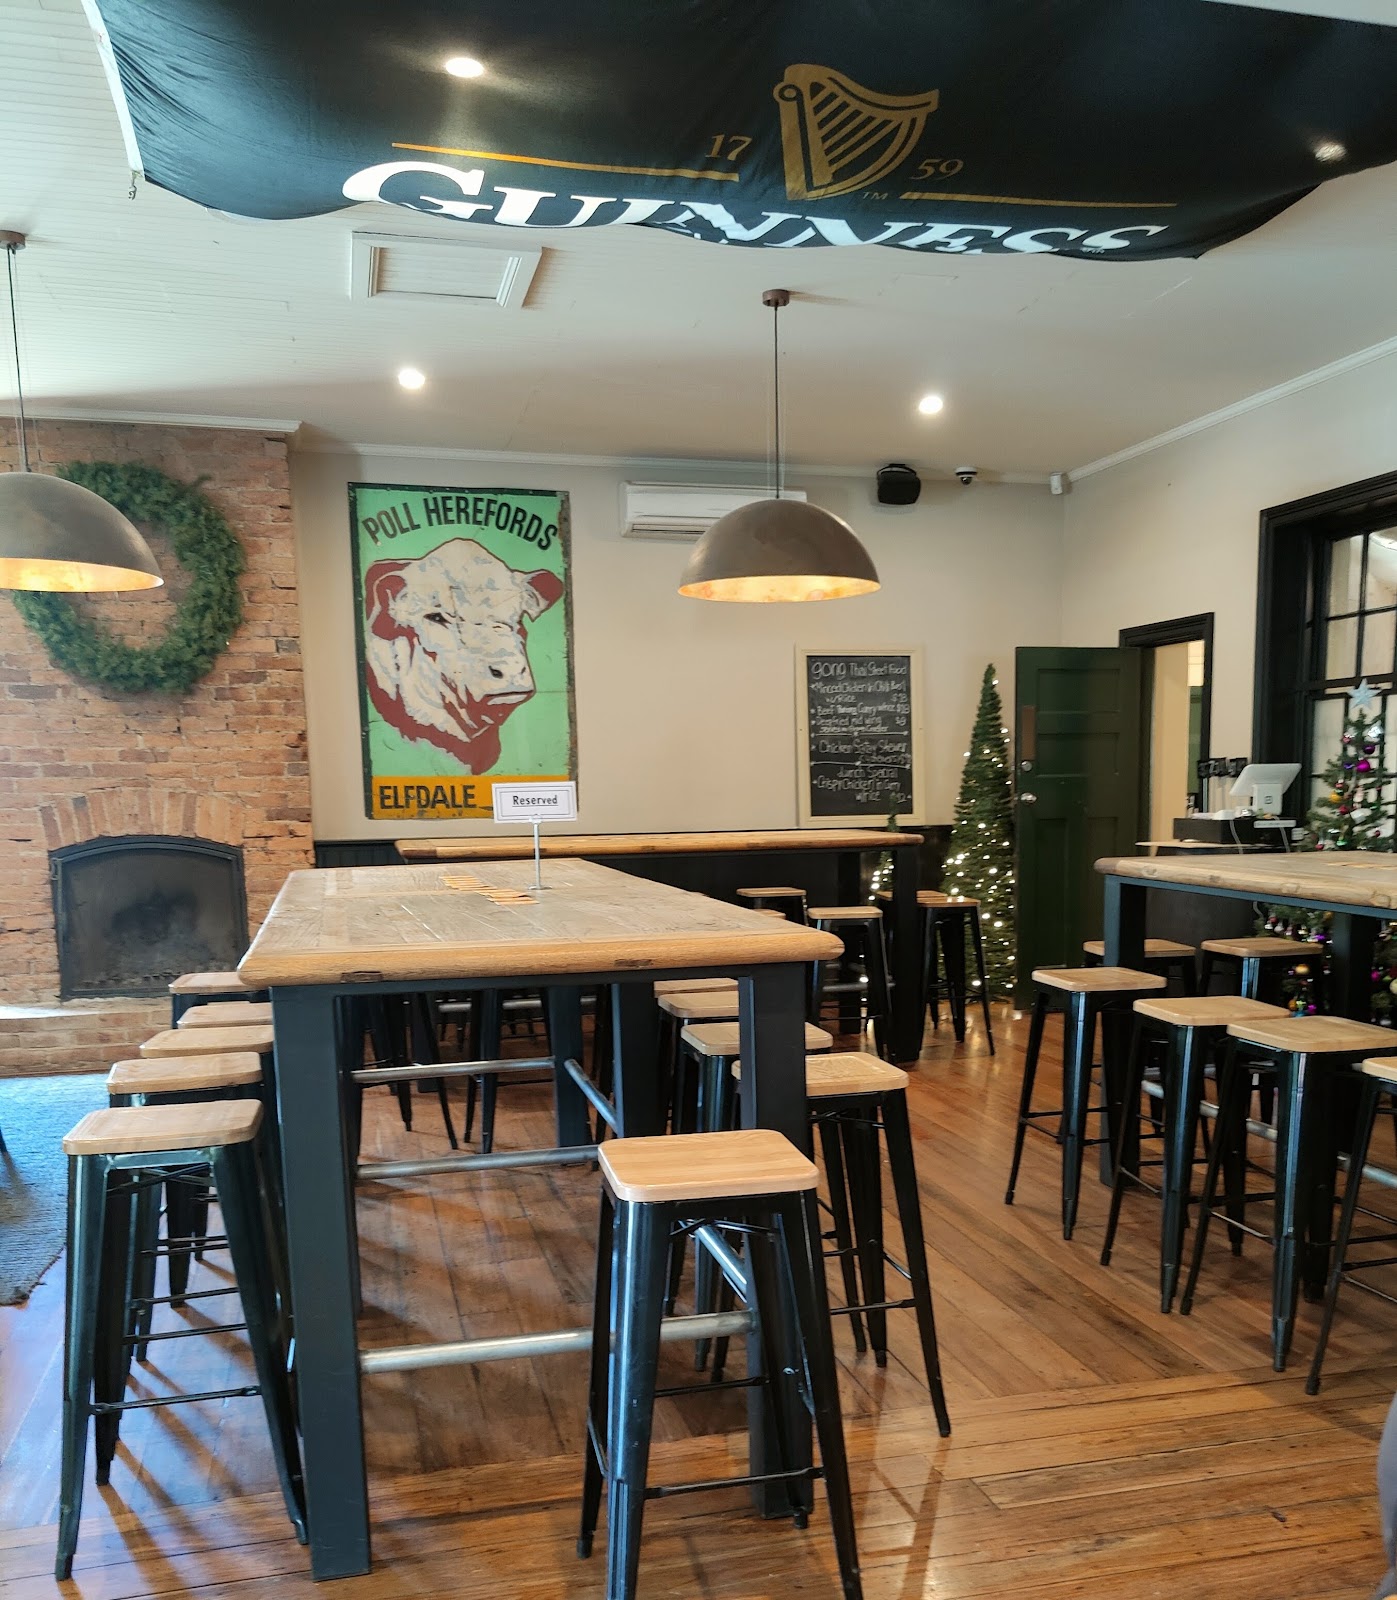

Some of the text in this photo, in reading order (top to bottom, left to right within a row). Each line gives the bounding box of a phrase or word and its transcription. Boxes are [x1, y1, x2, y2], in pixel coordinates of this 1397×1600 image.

[704, 133, 753, 161] 17
[909, 157, 964, 181] 59
[362, 495, 558, 551] POLL HEREFORDS
[888, 663, 907, 675] Food
[817, 704, 835, 717] Beef
[818, 739, 853, 754] Chicken
[379, 784, 477, 810] ELFDALE
[513, 794, 558, 808] Reserved
